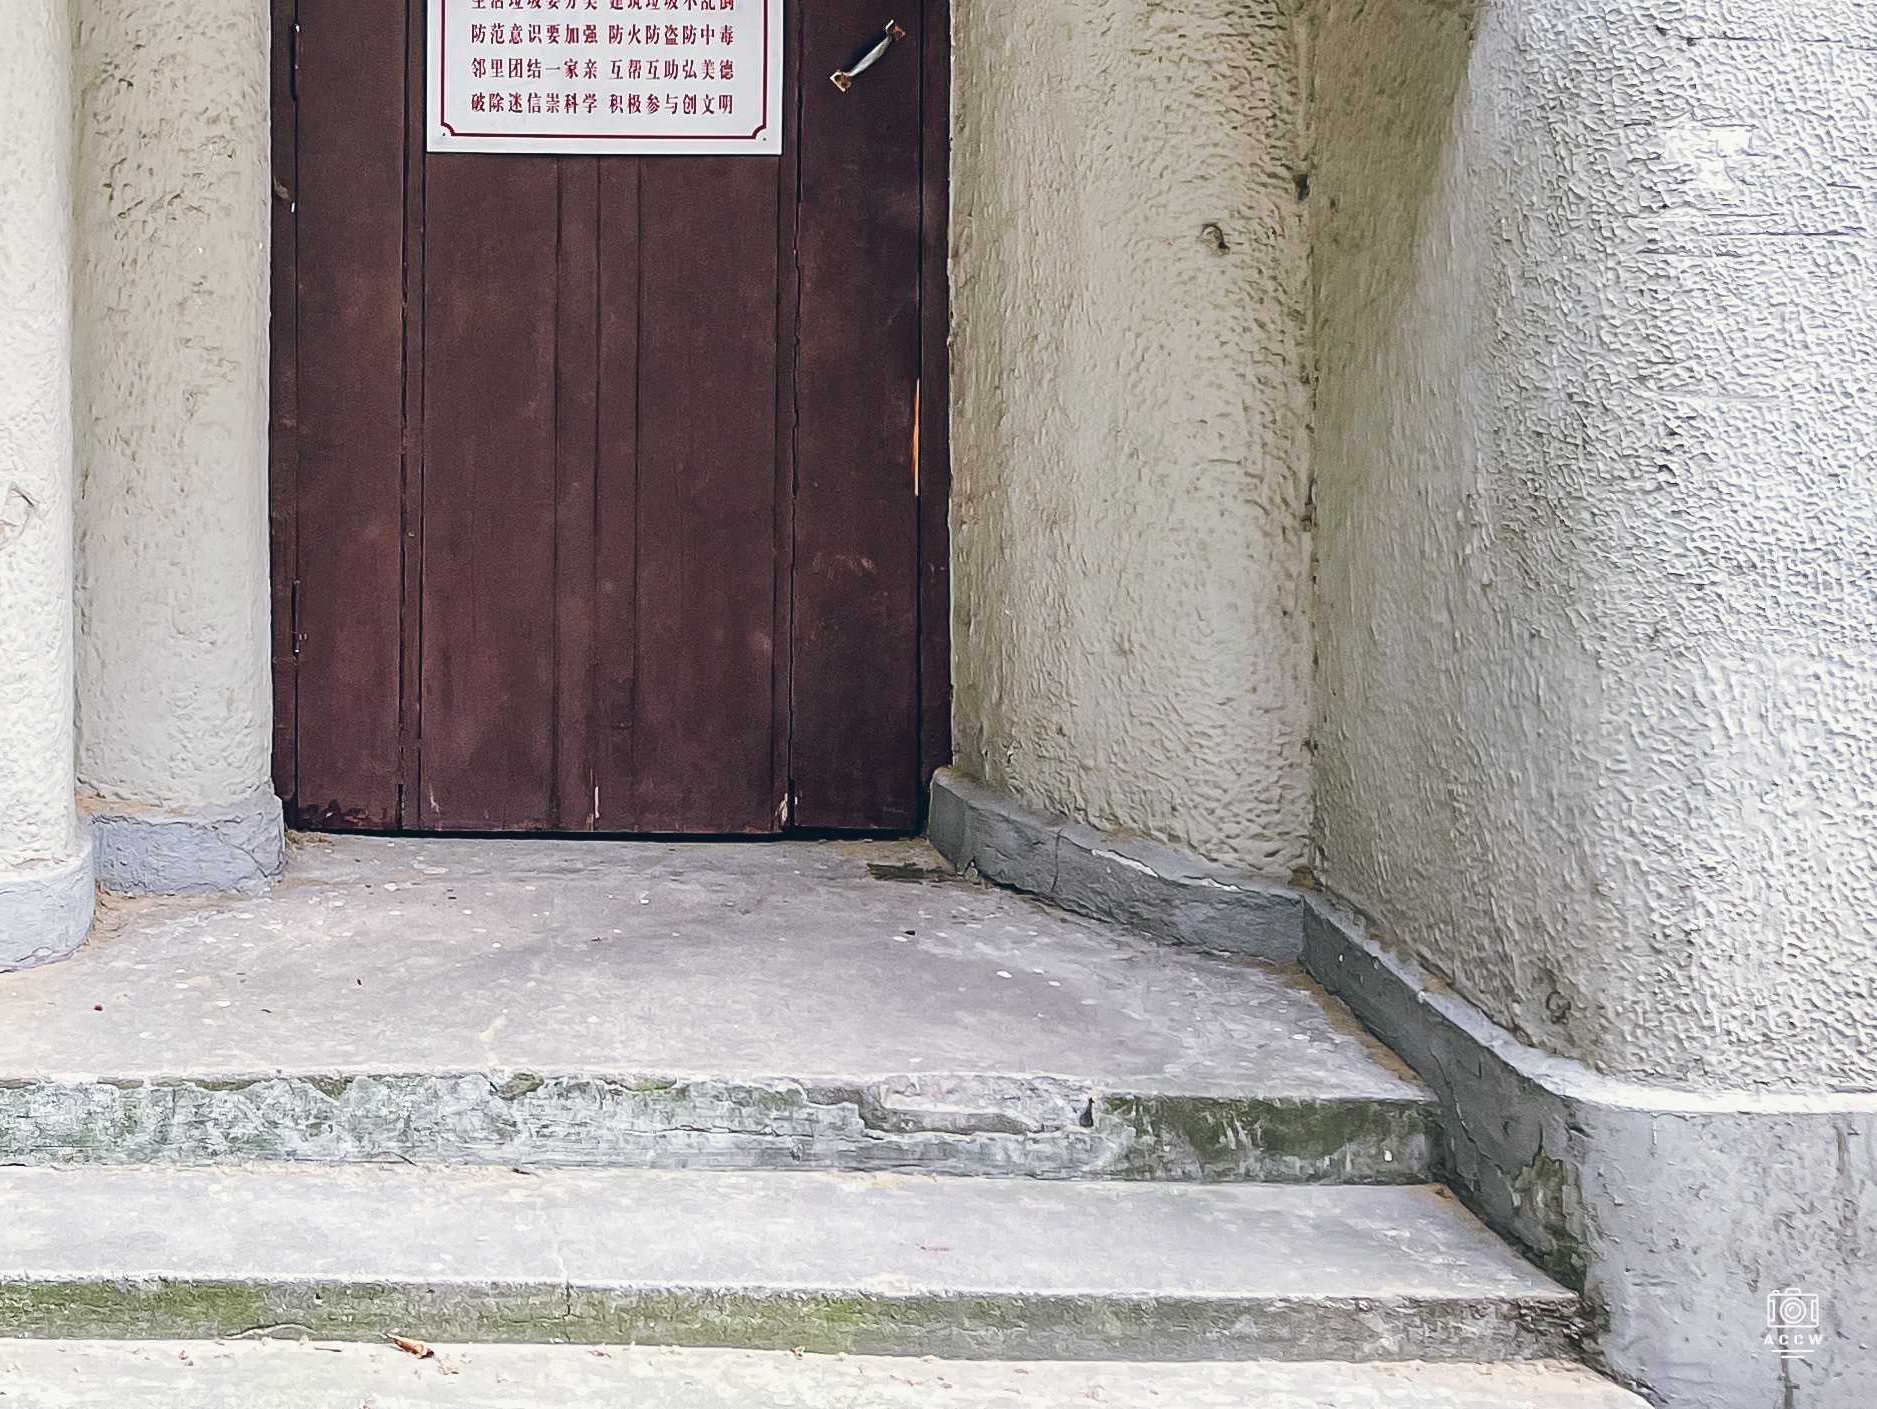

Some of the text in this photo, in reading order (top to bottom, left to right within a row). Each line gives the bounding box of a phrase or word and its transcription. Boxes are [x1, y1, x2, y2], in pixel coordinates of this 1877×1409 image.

[471, 23, 734, 45] 防范意识要加强 防火防盗防中毒
[471, 57, 734, 80] 邻里团结一家亲 互帮互助弘美德
[471, 92, 734, 115] 破除迷信崇科学 积极参与创文明
